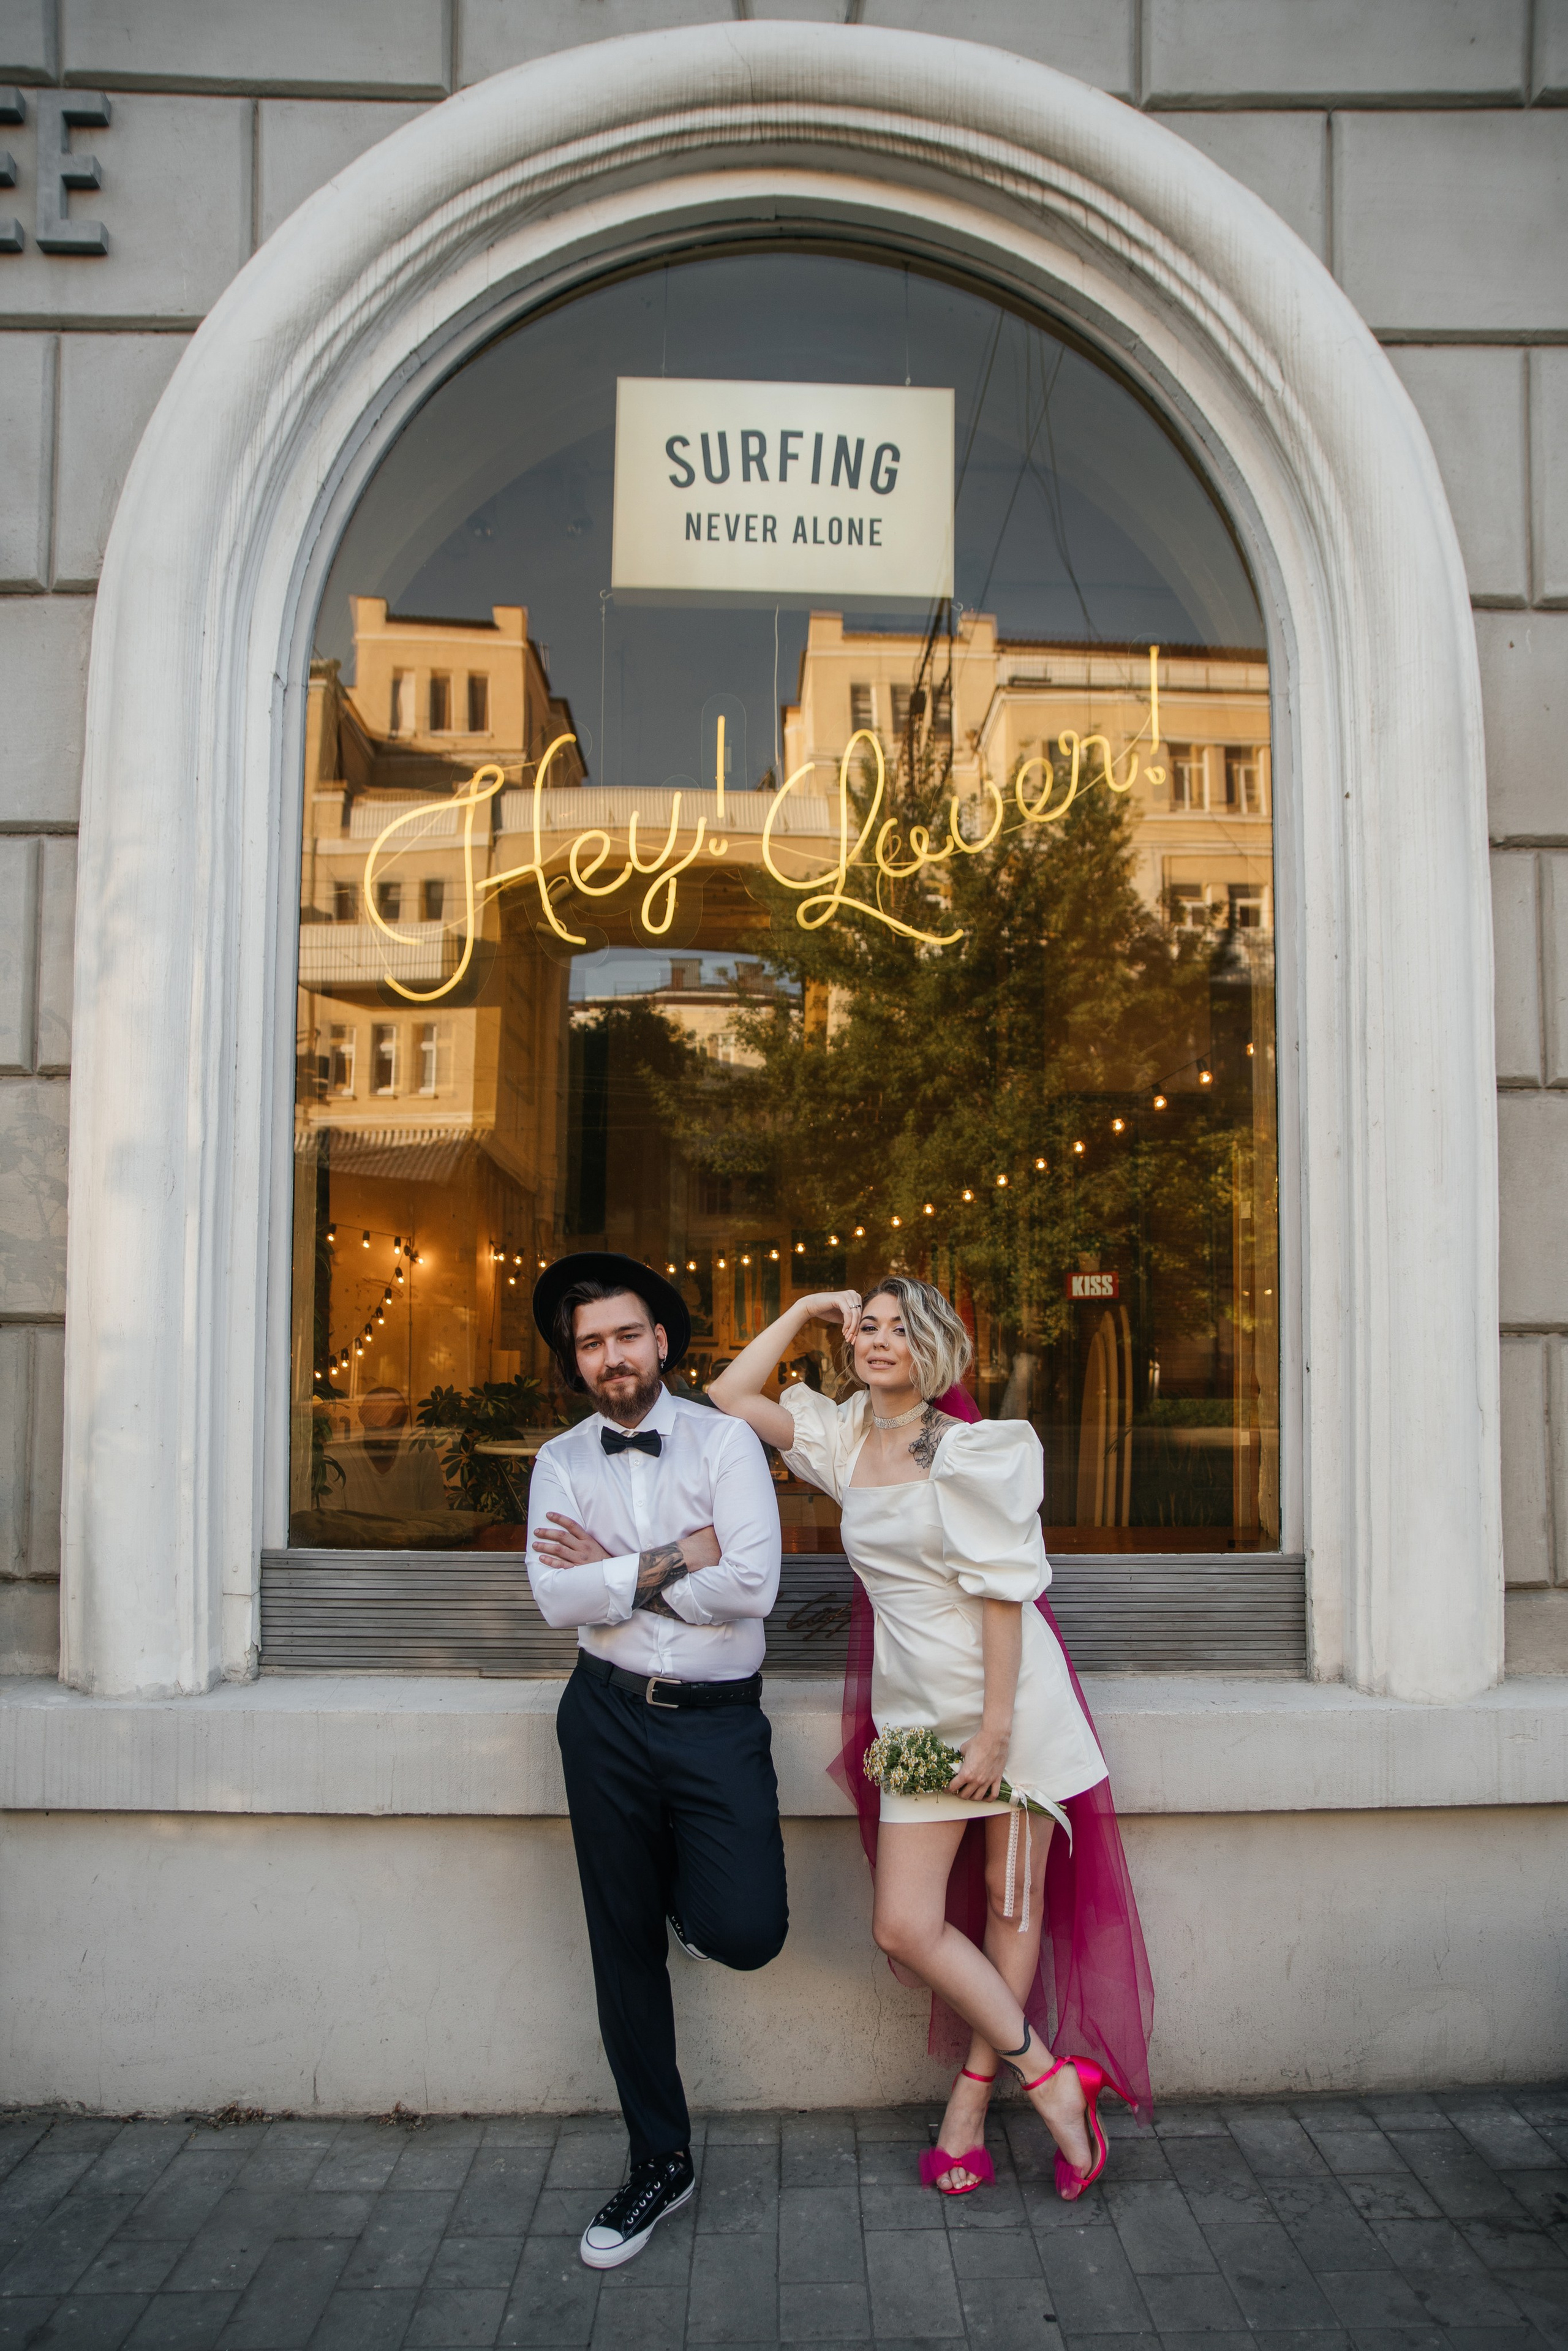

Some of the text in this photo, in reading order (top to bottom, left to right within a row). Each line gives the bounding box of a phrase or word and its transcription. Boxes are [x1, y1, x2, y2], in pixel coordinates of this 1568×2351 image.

[665, 429, 900, 495] SURFING
[684, 511, 883, 547] NEVER ALONE
[363, 645, 1166, 1002] Hey! Lover!
[1072, 1275, 1114, 1296] KISS
